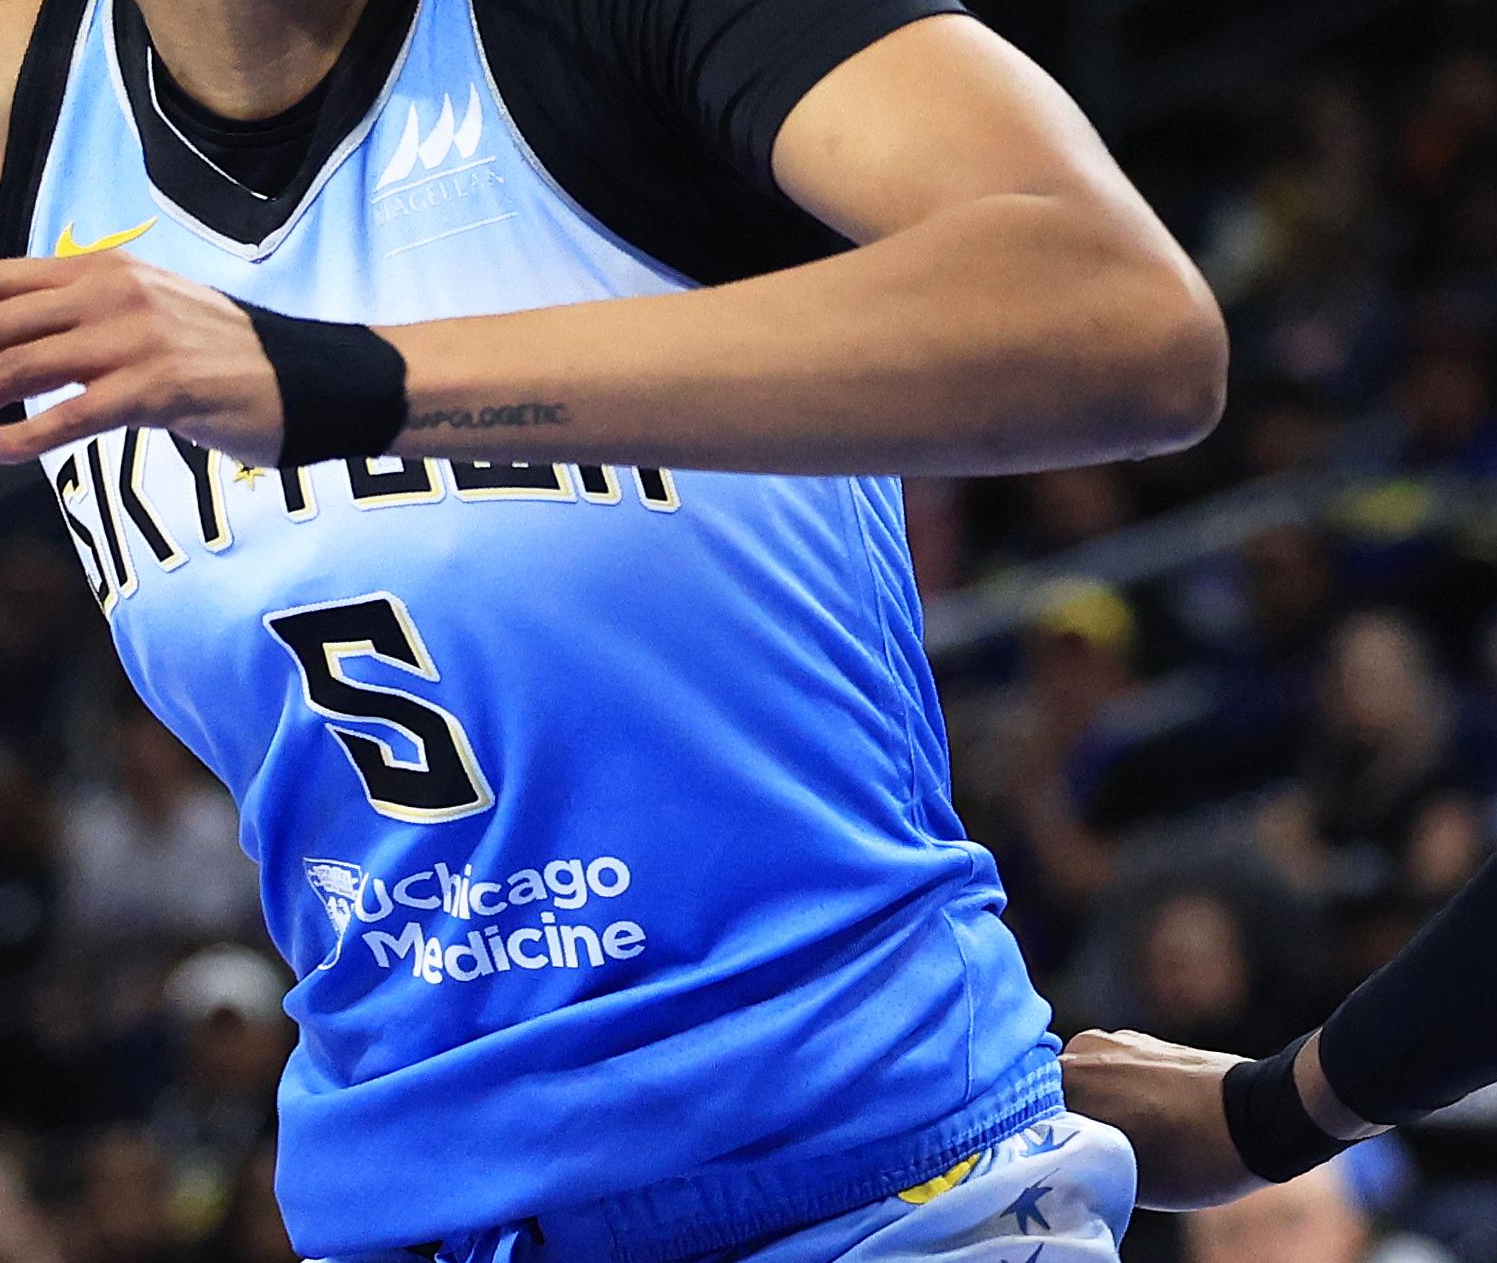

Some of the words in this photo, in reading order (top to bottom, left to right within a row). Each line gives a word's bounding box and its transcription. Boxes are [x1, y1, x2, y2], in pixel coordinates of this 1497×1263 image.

[262, 591, 495, 824] 5
[354, 856, 631, 923] UChicago
[361, 912, 647, 984] Medicine
